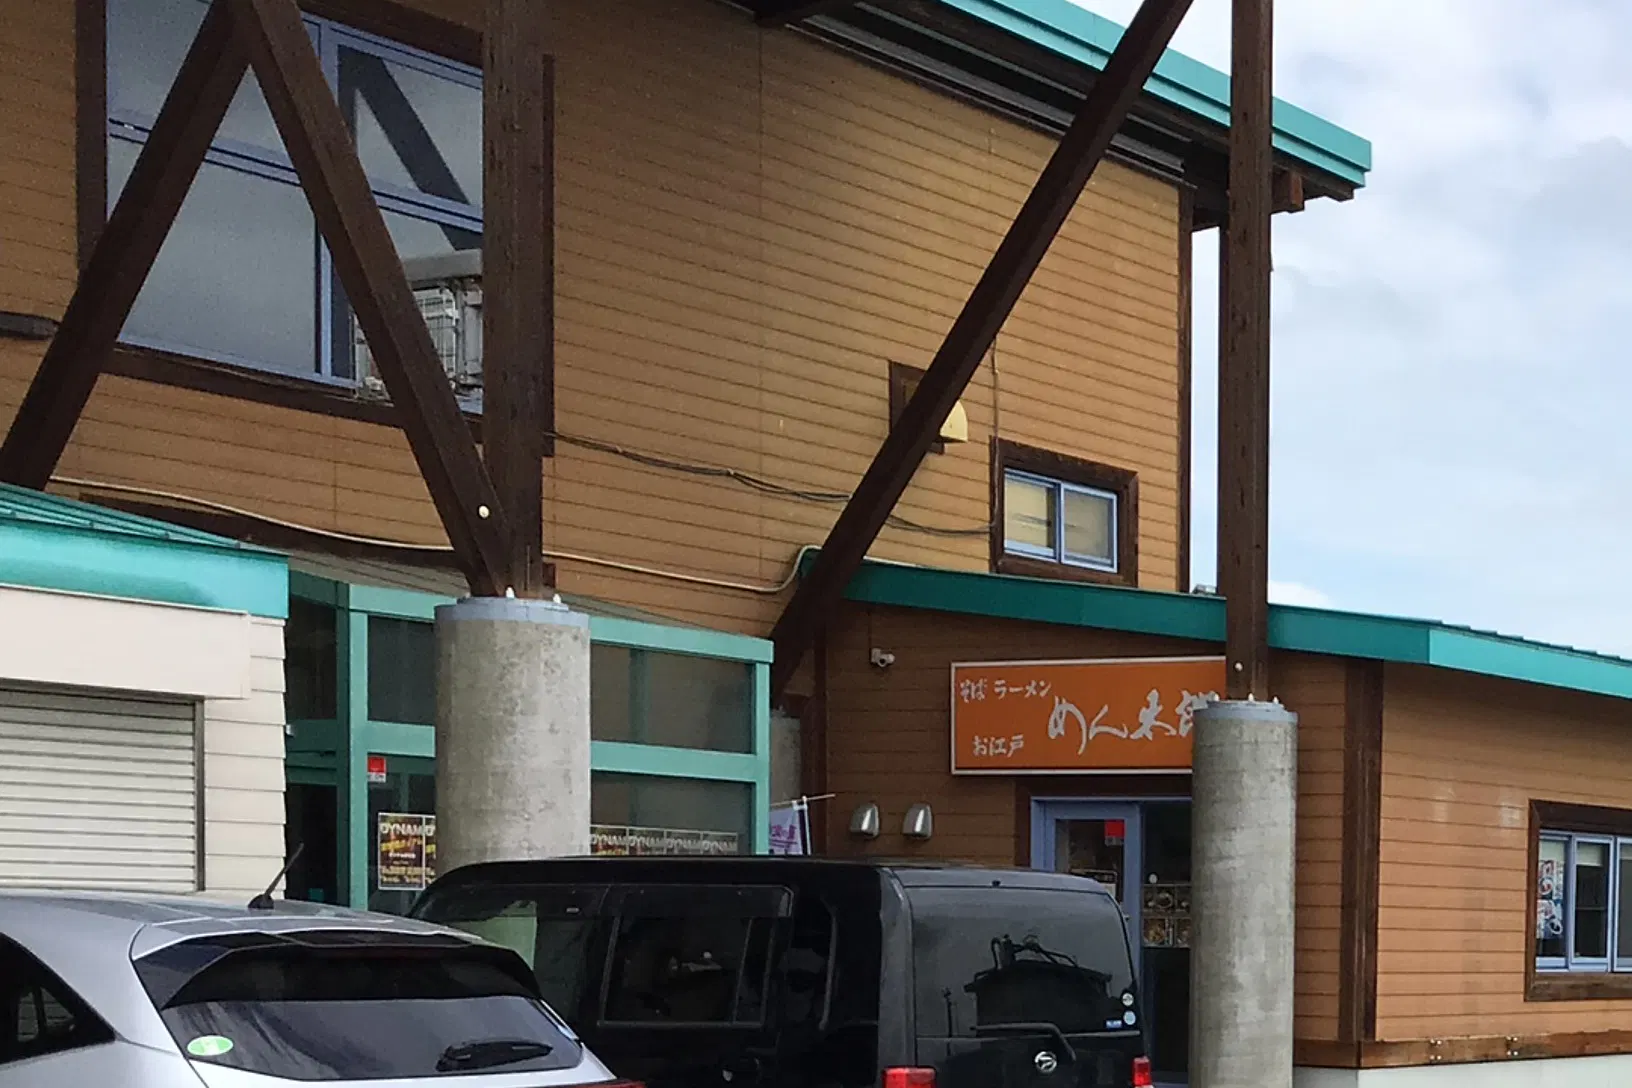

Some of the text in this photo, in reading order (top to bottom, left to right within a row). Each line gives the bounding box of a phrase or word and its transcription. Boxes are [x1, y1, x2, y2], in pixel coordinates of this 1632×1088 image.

[960, 678, 1052, 703] そば ラーメン
[973, 734, 1025, 757] お江戸
